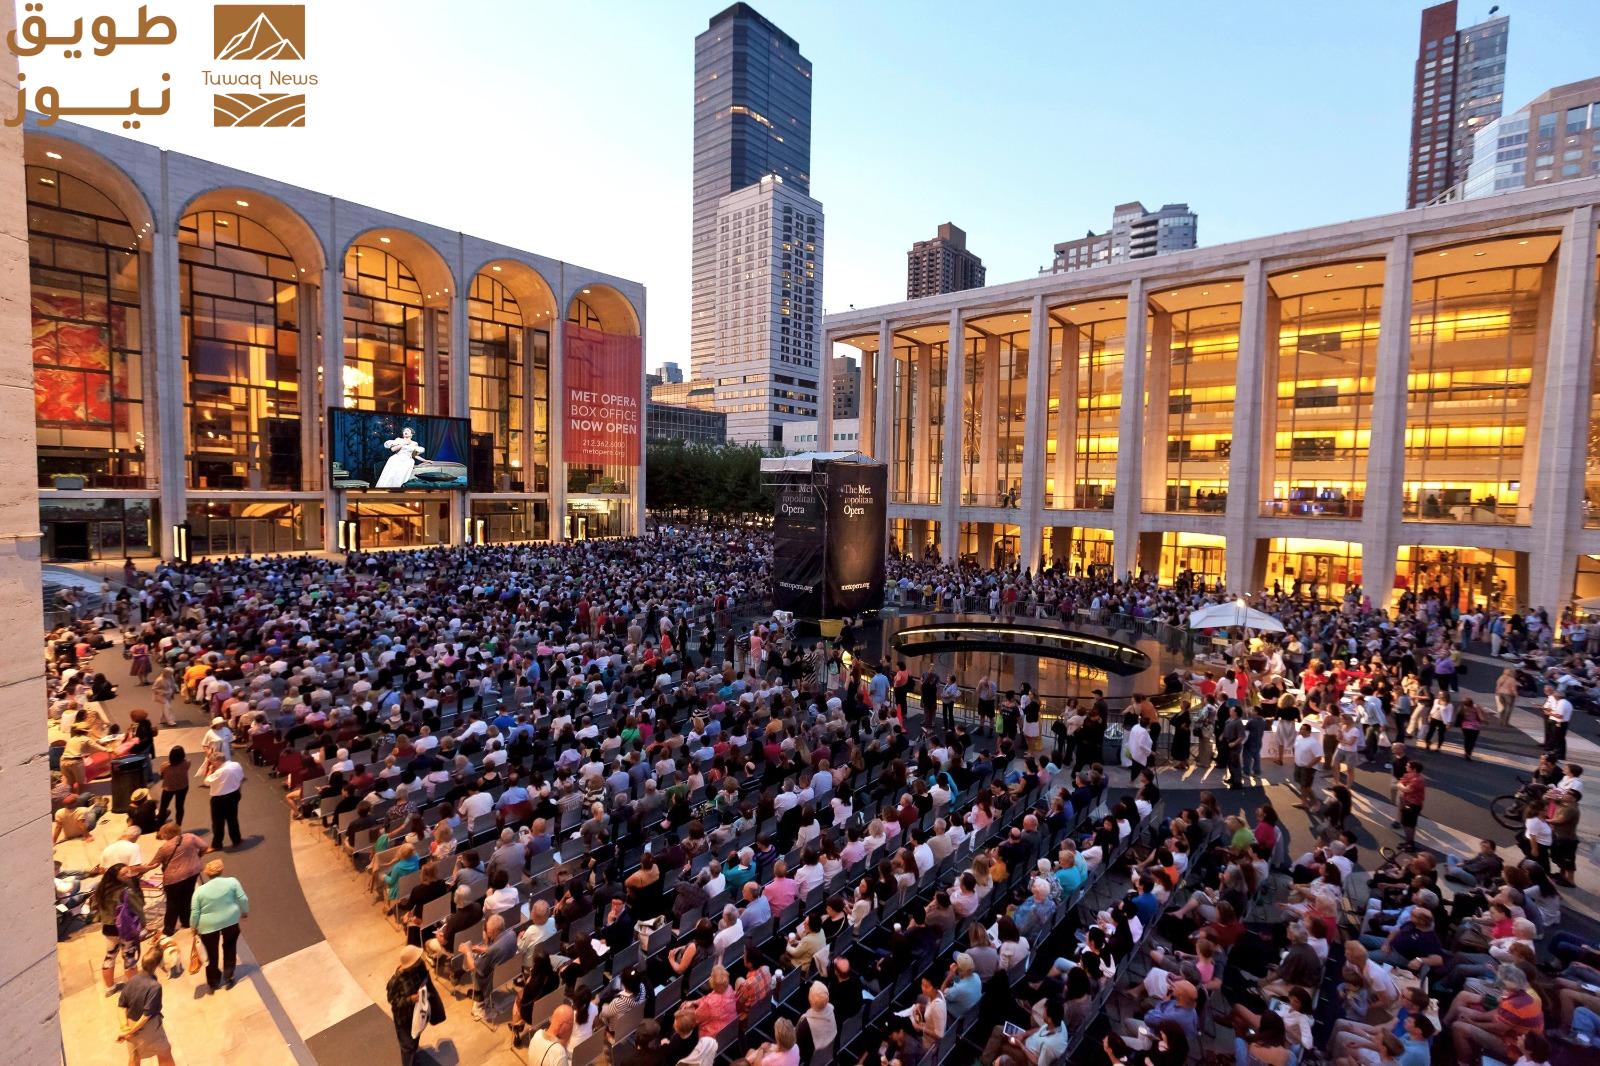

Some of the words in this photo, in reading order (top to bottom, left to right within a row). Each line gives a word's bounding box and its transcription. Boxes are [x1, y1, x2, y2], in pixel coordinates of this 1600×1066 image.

[571, 389, 598, 403] MET
[601, 393, 637, 408] OPERA
[571, 404, 597, 418] BOX
[599, 407, 637, 421] OFFICE
[571, 419, 603, 432] NOW
[605, 422, 637, 435] OPEN
[582, 448, 625, 458] metopera.org
[843, 484, 857, 494] The
[858, 484, 871, 494] Met
[781, 503, 805, 516] Opera
[843, 504, 865, 518] Opera
